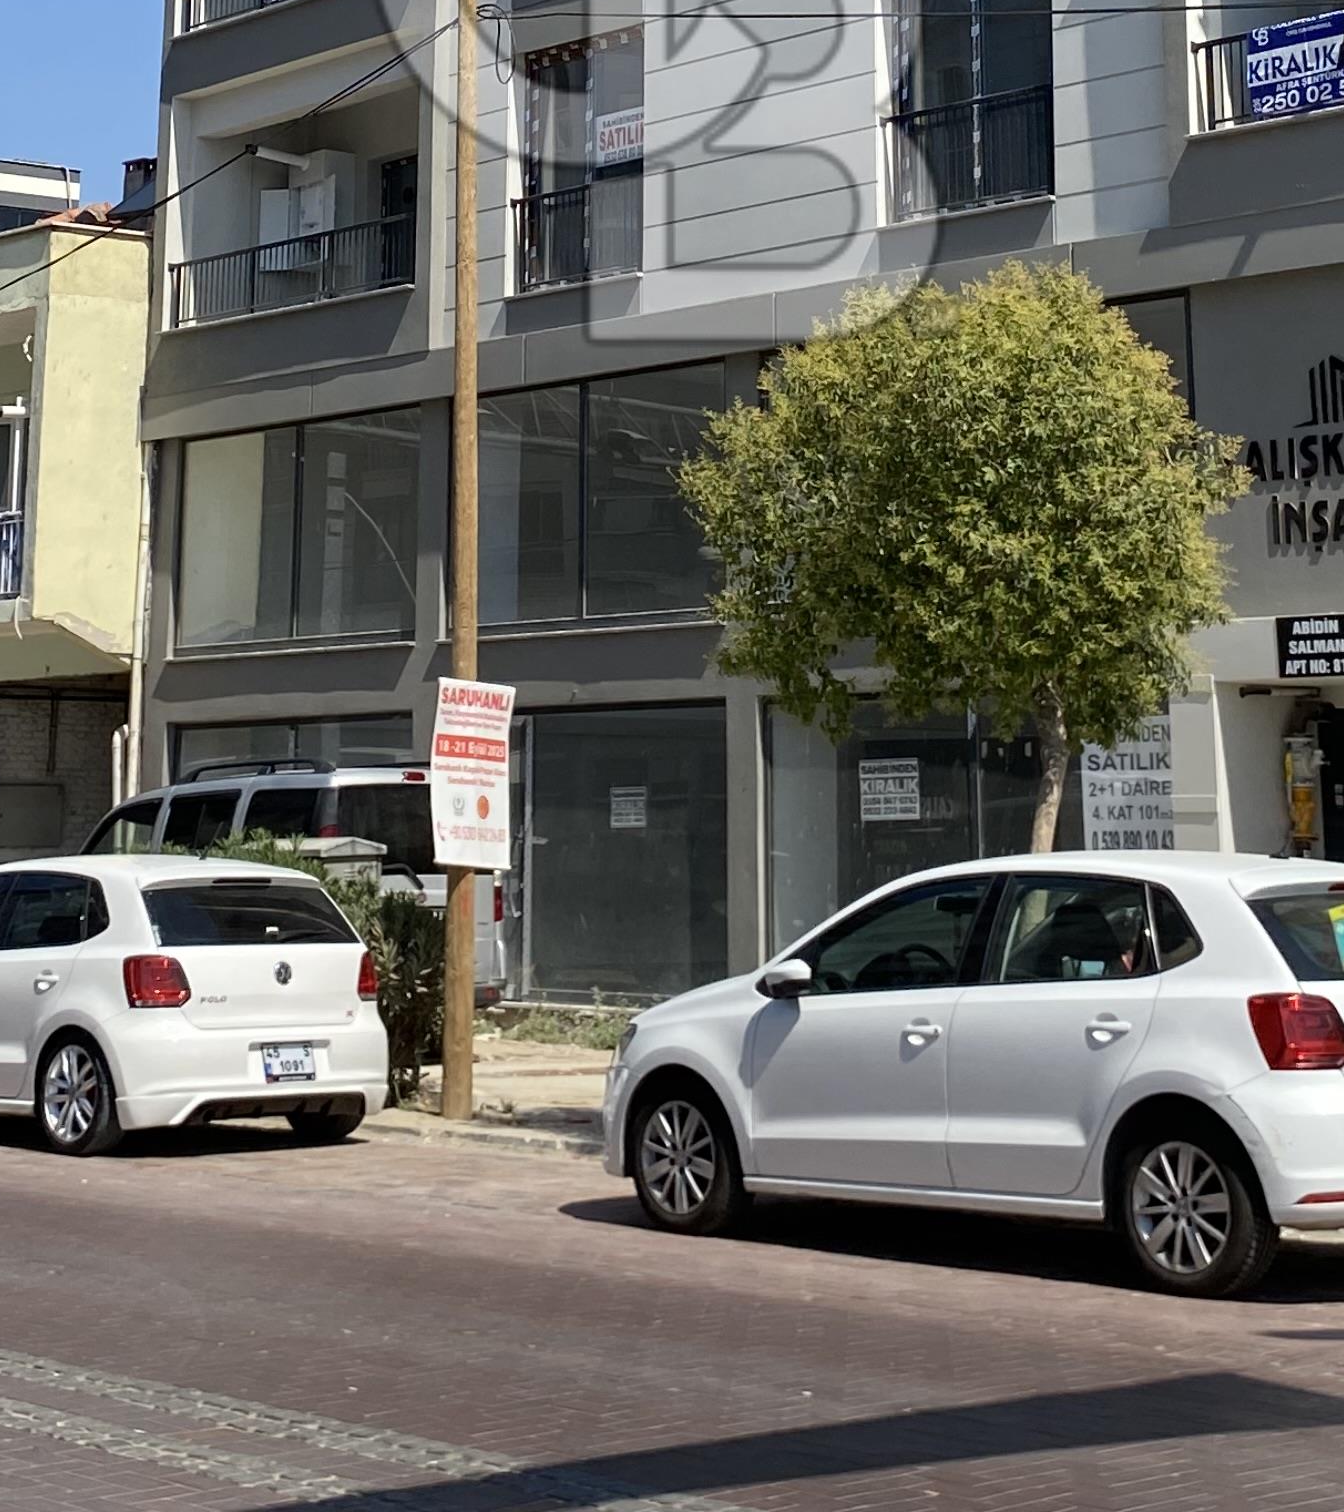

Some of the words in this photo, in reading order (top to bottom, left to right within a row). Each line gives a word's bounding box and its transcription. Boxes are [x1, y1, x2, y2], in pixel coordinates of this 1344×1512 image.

[1262, 90, 1300, 113] 250
[1306, 82, 1332, 103] 02
[1292, 618, 1338, 635] ABİDİN
[1288, 638, 1344, 655] SALMAN
[1286, 660, 1306, 675] APT
[1310, 660, 1331, 675] NO:
[442, 686, 510, 712] SARUHANLI
[439, 739, 449, 753] 18
[1088, 752, 1170, 771] SATILIK
[1089, 782, 1114, 797] 2+1
[1121, 778, 1172, 796] DAİRE
[1108, 805, 1133, 820] KAT
[280, 1060, 304, 1072] 1091
